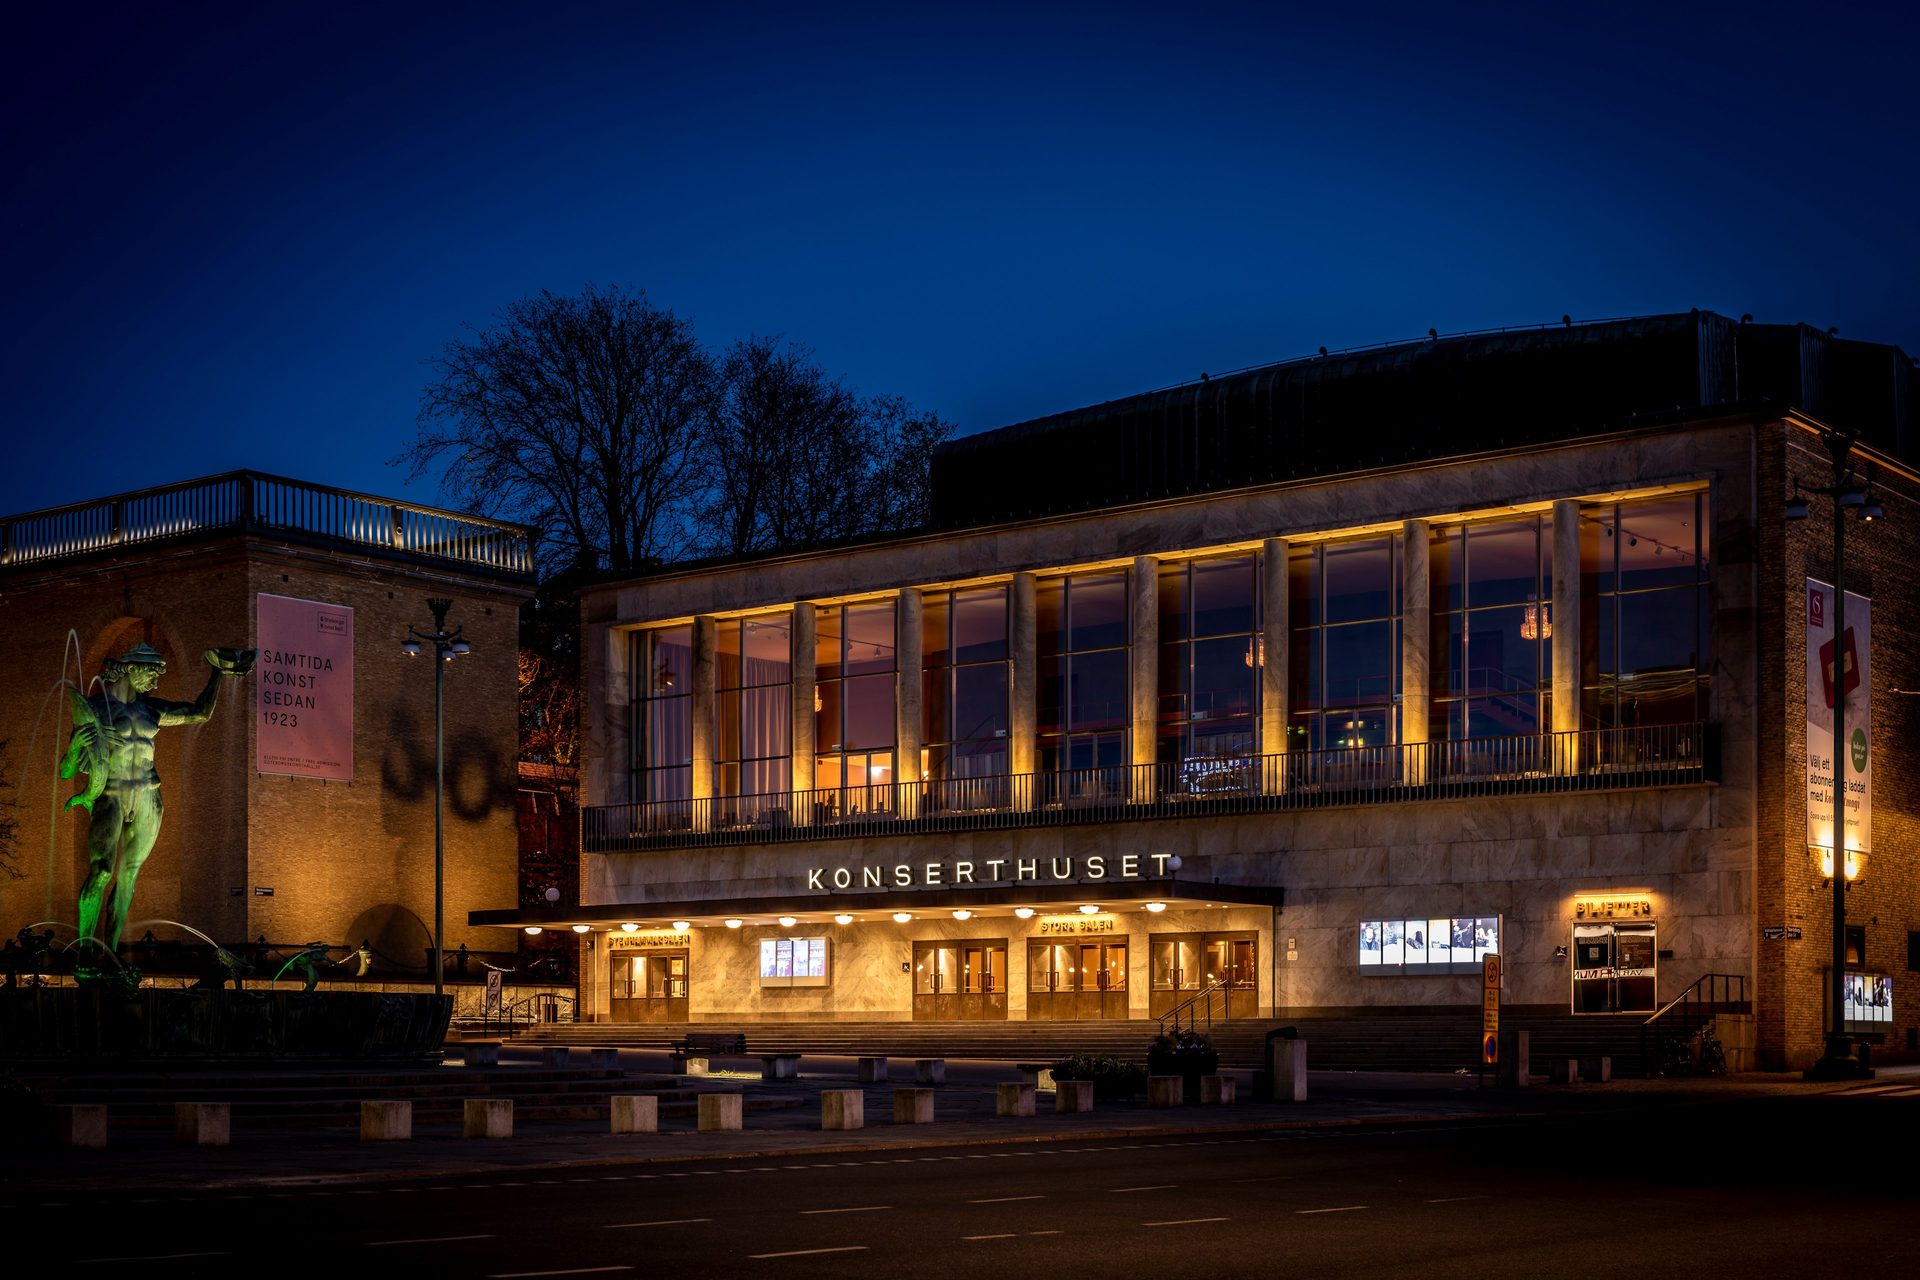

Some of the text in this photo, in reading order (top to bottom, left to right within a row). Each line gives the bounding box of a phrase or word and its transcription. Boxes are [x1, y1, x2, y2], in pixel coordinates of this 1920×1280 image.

[263, 650, 333, 672] SAMTIDA
[263, 670, 316, 689] KONST
[263, 690, 315, 709] SEDAN
[263, 711, 298, 728] 1923
[1821, 758, 1830, 771] ett
[1848, 778, 1866, 794] laddat
[1809, 790, 1823, 802] med
[808, 853, 1174, 890] KONSERTHUSET
[1576, 902, 1650, 915] BILJETTER
[1041, 919, 1113, 933] STORA SALEN
